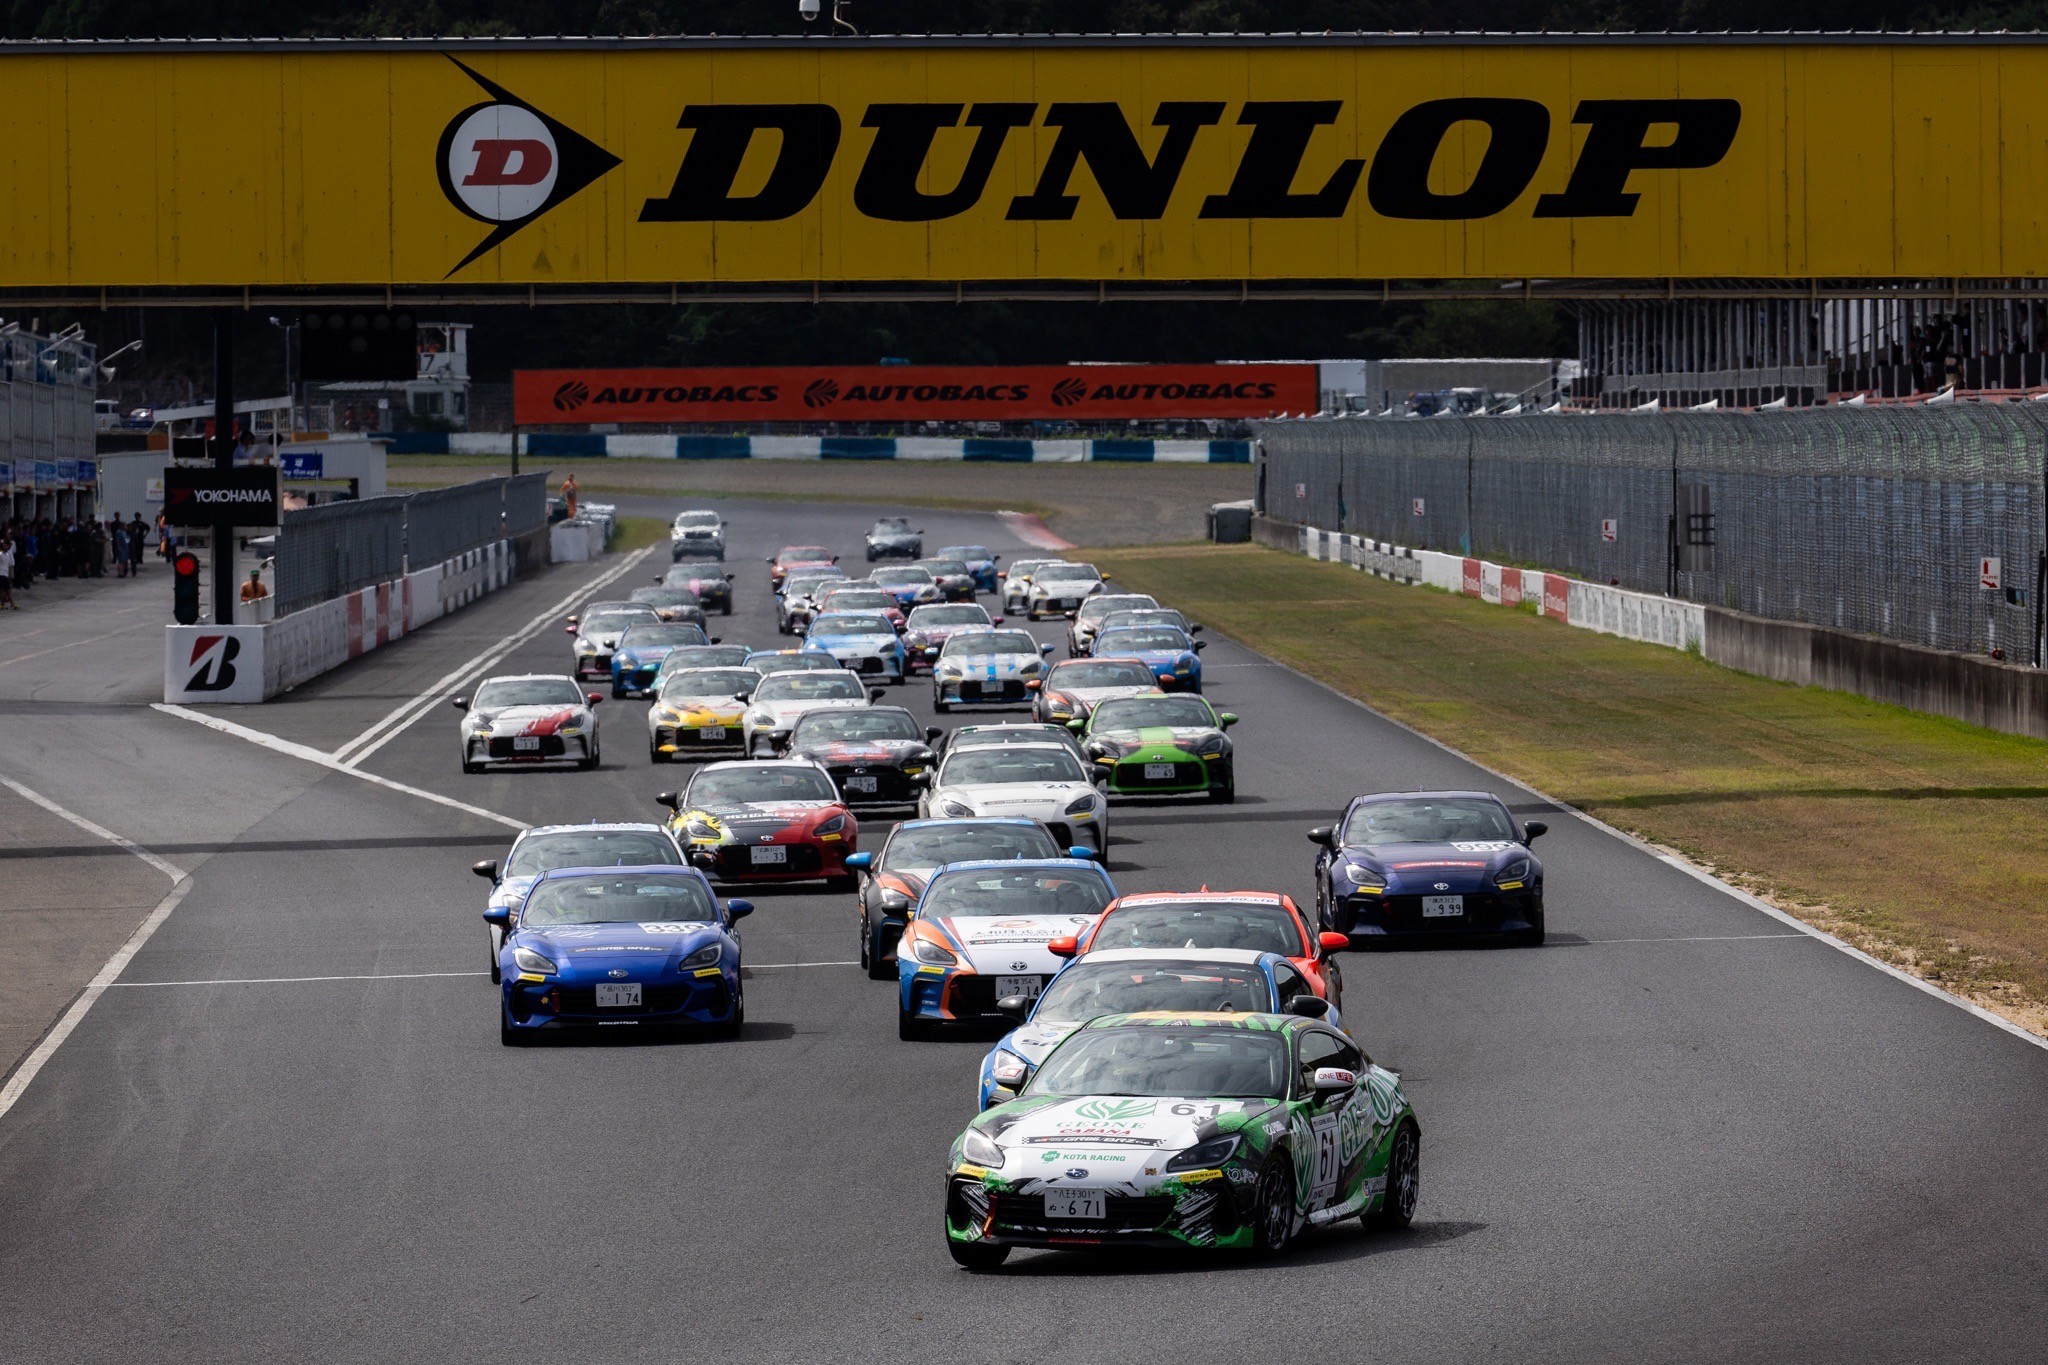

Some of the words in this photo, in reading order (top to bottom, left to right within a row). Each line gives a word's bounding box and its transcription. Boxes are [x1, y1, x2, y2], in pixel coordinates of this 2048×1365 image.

[637, 97, 1741, 222] DUNLOP
[593, 385, 779, 404] AUTOBACS
[841, 384, 1029, 403] AUTOBACS
[1090, 382, 1277, 400] AUTOBACS
[194, 489, 272, 503] YOKOHAMA
[1438, 903, 1461, 915] 999
[1318, 1072, 1335, 1080] ONE
[1336, 1072, 1352, 1082] LIFE
[1170, 1103, 1221, 1116] 61
[1056, 1121, 1146, 1129] GEONE
[1089, 1154, 1126, 1162] RACING
[1320, 1129, 1335, 1183] 61
[1189, 1171, 1219, 1179] DUNLOP
[1058, 1189, 1091, 1199] 八王子301
